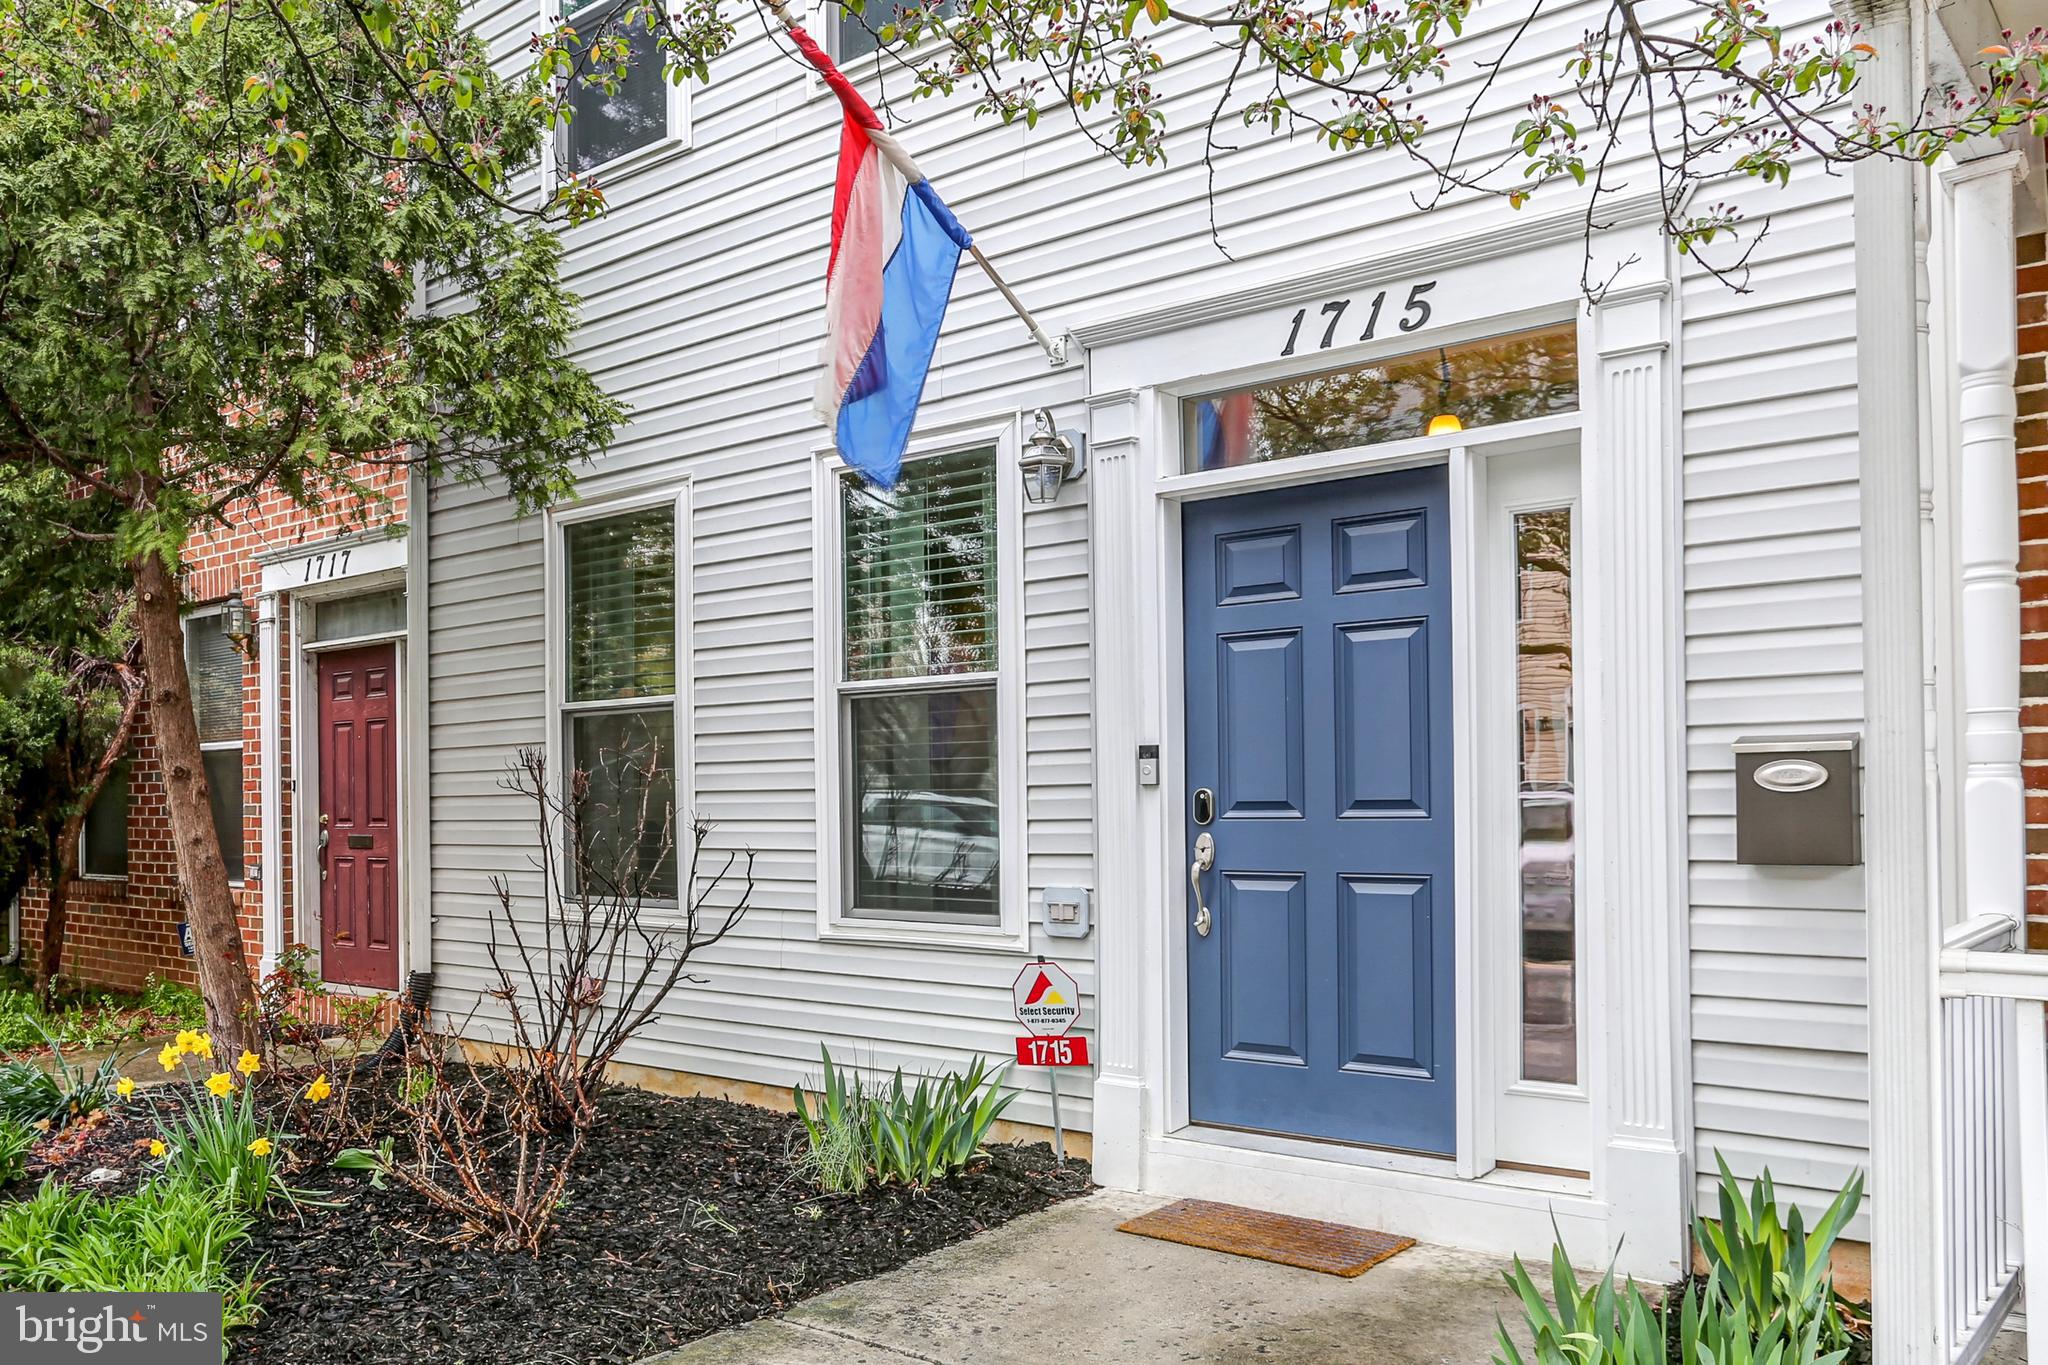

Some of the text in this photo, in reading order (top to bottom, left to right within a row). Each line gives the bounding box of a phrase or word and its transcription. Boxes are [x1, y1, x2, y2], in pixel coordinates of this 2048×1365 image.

[1281, 280, 1437, 356] 1715
[304, 550, 352, 582] 1717
[1019, 1006, 1075, 1016] Select Security
[1027, 1039, 1073, 1065] 1715
